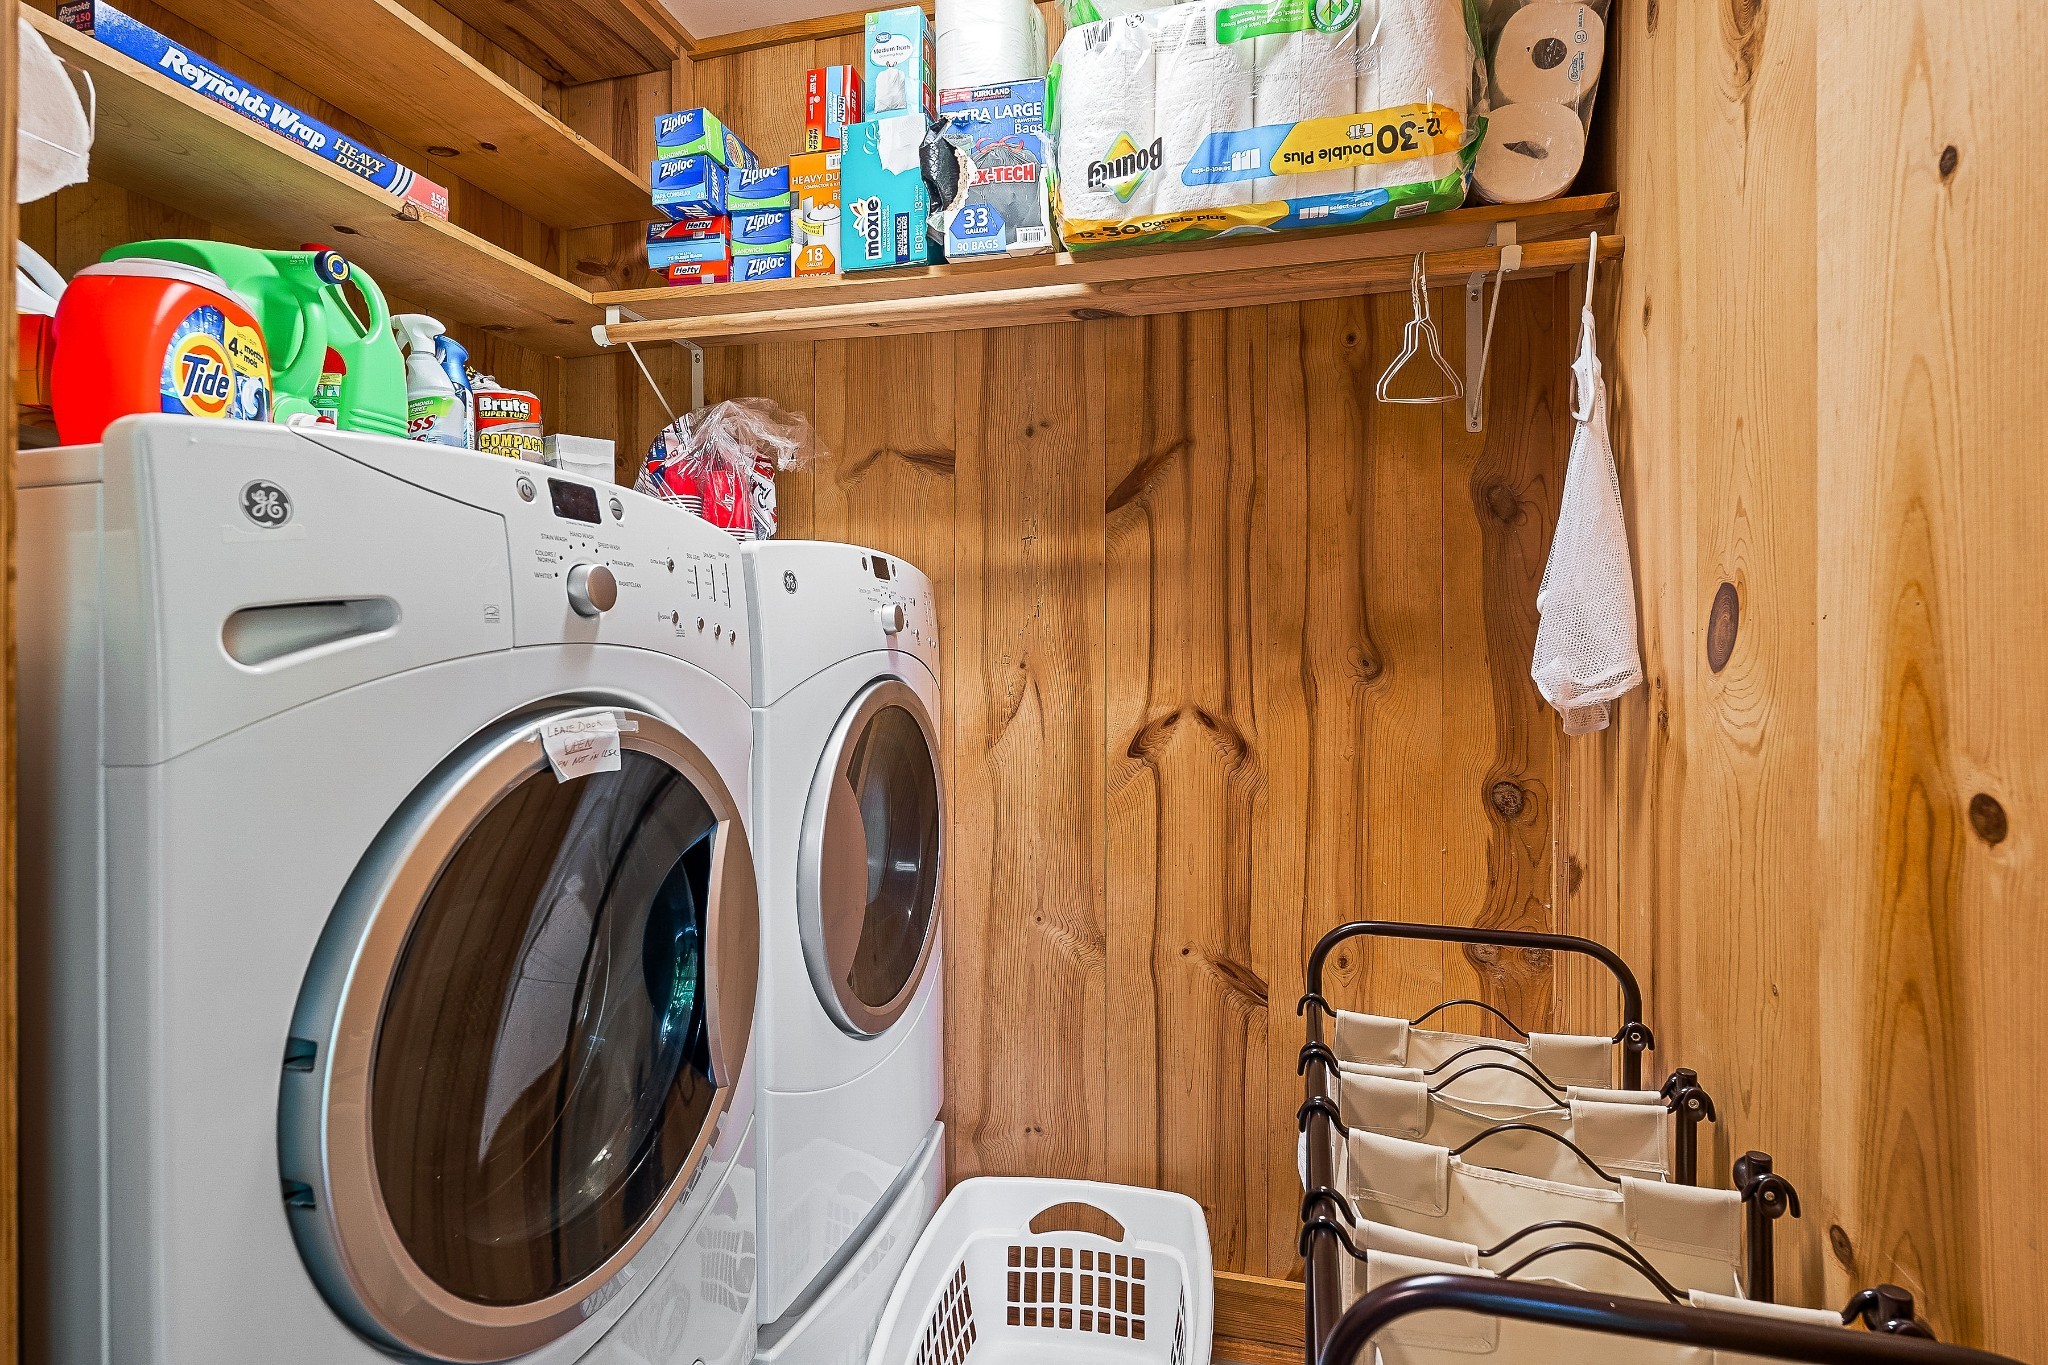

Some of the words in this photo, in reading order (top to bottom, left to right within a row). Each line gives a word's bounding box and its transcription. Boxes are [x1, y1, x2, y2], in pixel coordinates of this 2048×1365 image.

[59, 1, 91, 15] Reynolds
[75, 12, 91, 23] 150
[873, 45, 896, 54] Medium
[159, 46, 271, 119] Reynolds
[269, 102, 326, 151] Wrap
[973, 87, 1011, 98] KIRKLAND
[994, 102, 1043, 119] LARGE
[661, 112, 693, 135] Ziploc
[1014, 123, 1043, 136] Bags
[333, 138, 385, 173] HEAVY
[660, 149, 689, 160] SANDWICH
[1283, 150, 1315, 166] Plus
[1319, 142, 1375, 163] Double
[336, 154, 375, 179] DUTY
[660, 159, 693, 179] Ziploc
[1087, 137, 1163, 189] Bounty
[711, 163, 720, 203] Ziploc
[741, 167, 778, 185] Ziploc
[791, 174, 823, 185] HEAVY
[430, 192, 447, 206] 150
[914, 201, 924, 213] 13
[687, 221, 711, 230] Hefty
[746, 213, 783, 233] Ziploc
[963, 207, 989, 228] 33
[1141, 216, 1194, 229] Double
[1196, 214, 1227, 222] Plus
[867, 198, 880, 257] moxie
[965, 227, 989, 235] GALLON
[914, 235, 924, 254] 180
[957, 243, 969, 252] 90
[971, 239, 999, 250] BAGS
[806, 247, 824, 262] 18
[675, 266, 700, 274] Hefty
[748, 256, 786, 276] Ziploc
[243, 344, 265, 364] months
[243, 355, 259, 369] mois
[182, 354, 231, 399] Tide
[479, 397, 529, 413] Brute
[480, 433, 545, 454] COMPACT
[540, 533, 555, 541] STAIN
[537, 557, 558, 565] NORMAL
[533, 571, 553, 580] WHITES
